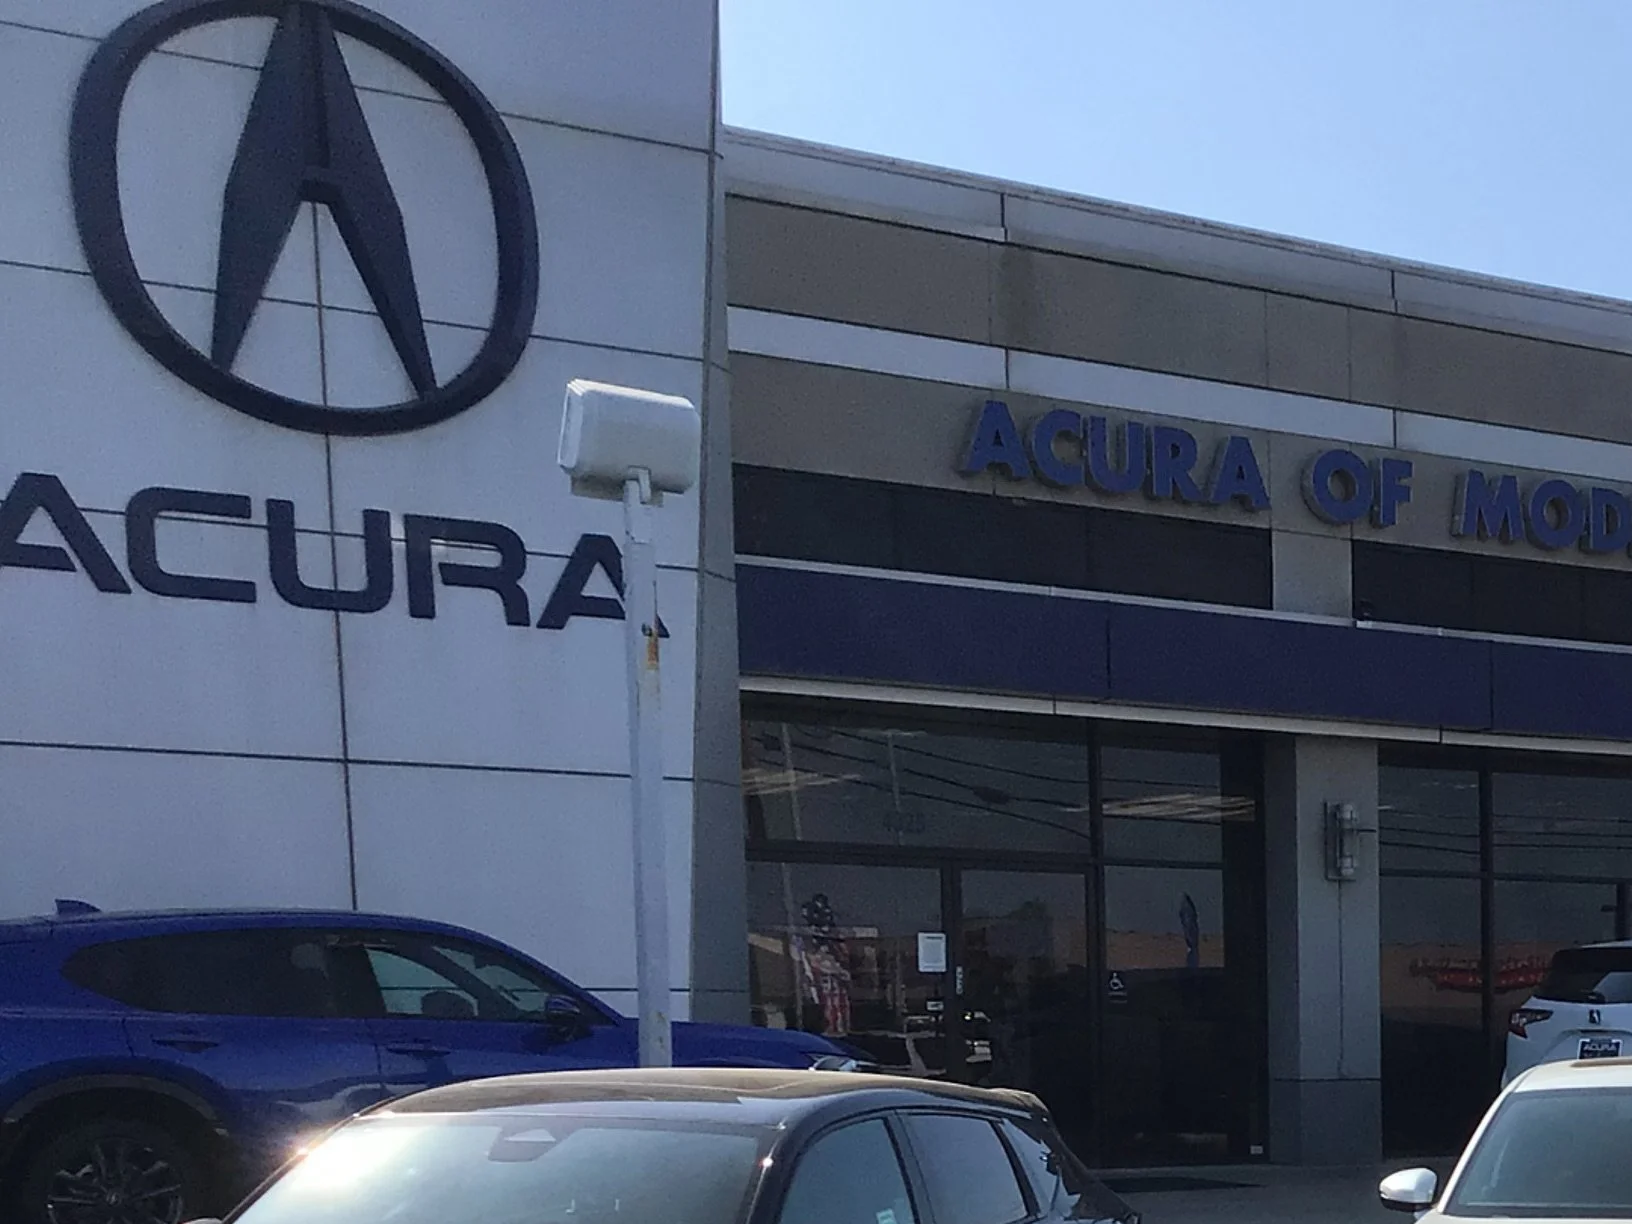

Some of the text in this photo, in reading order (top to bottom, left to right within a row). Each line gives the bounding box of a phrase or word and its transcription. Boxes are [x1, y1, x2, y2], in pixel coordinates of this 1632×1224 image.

[964, 400, 1271, 511] ACURA
[1310, 448, 1413, 527] OF
[0, 472, 670, 638] ACURA
